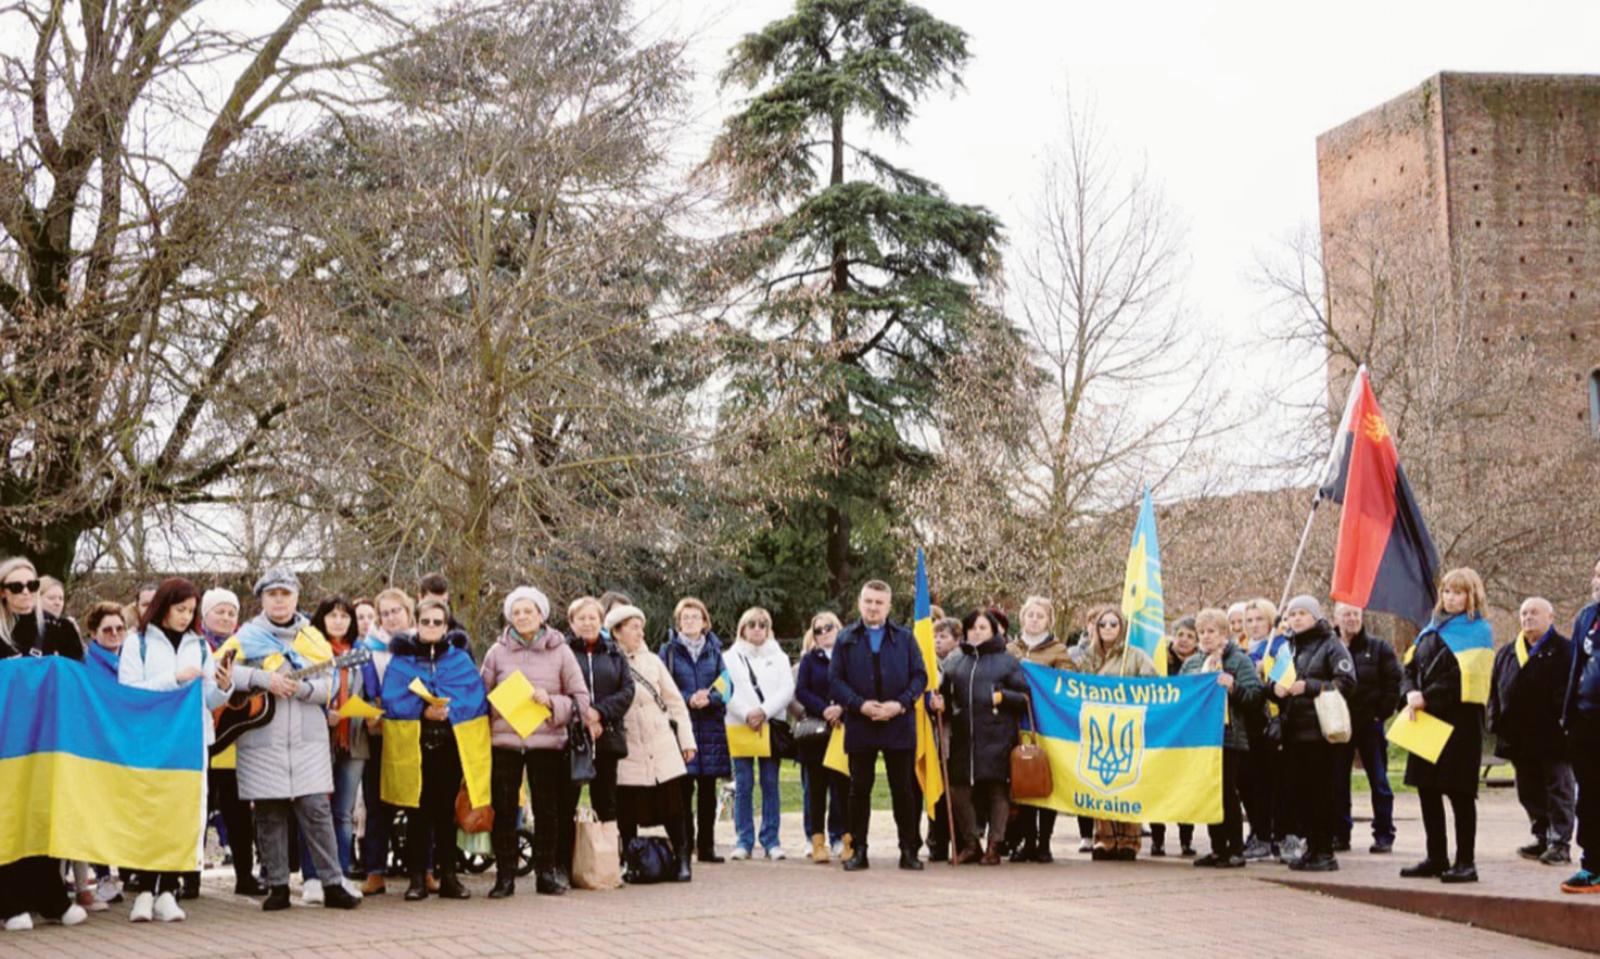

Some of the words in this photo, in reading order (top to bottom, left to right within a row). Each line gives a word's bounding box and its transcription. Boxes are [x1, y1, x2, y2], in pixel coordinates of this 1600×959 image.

[1054, 676, 1062, 695] I
[1066, 678, 1127, 703] Stand
[1129, 682, 1181, 704] With
[1074, 791, 1142, 814] Ukraine
